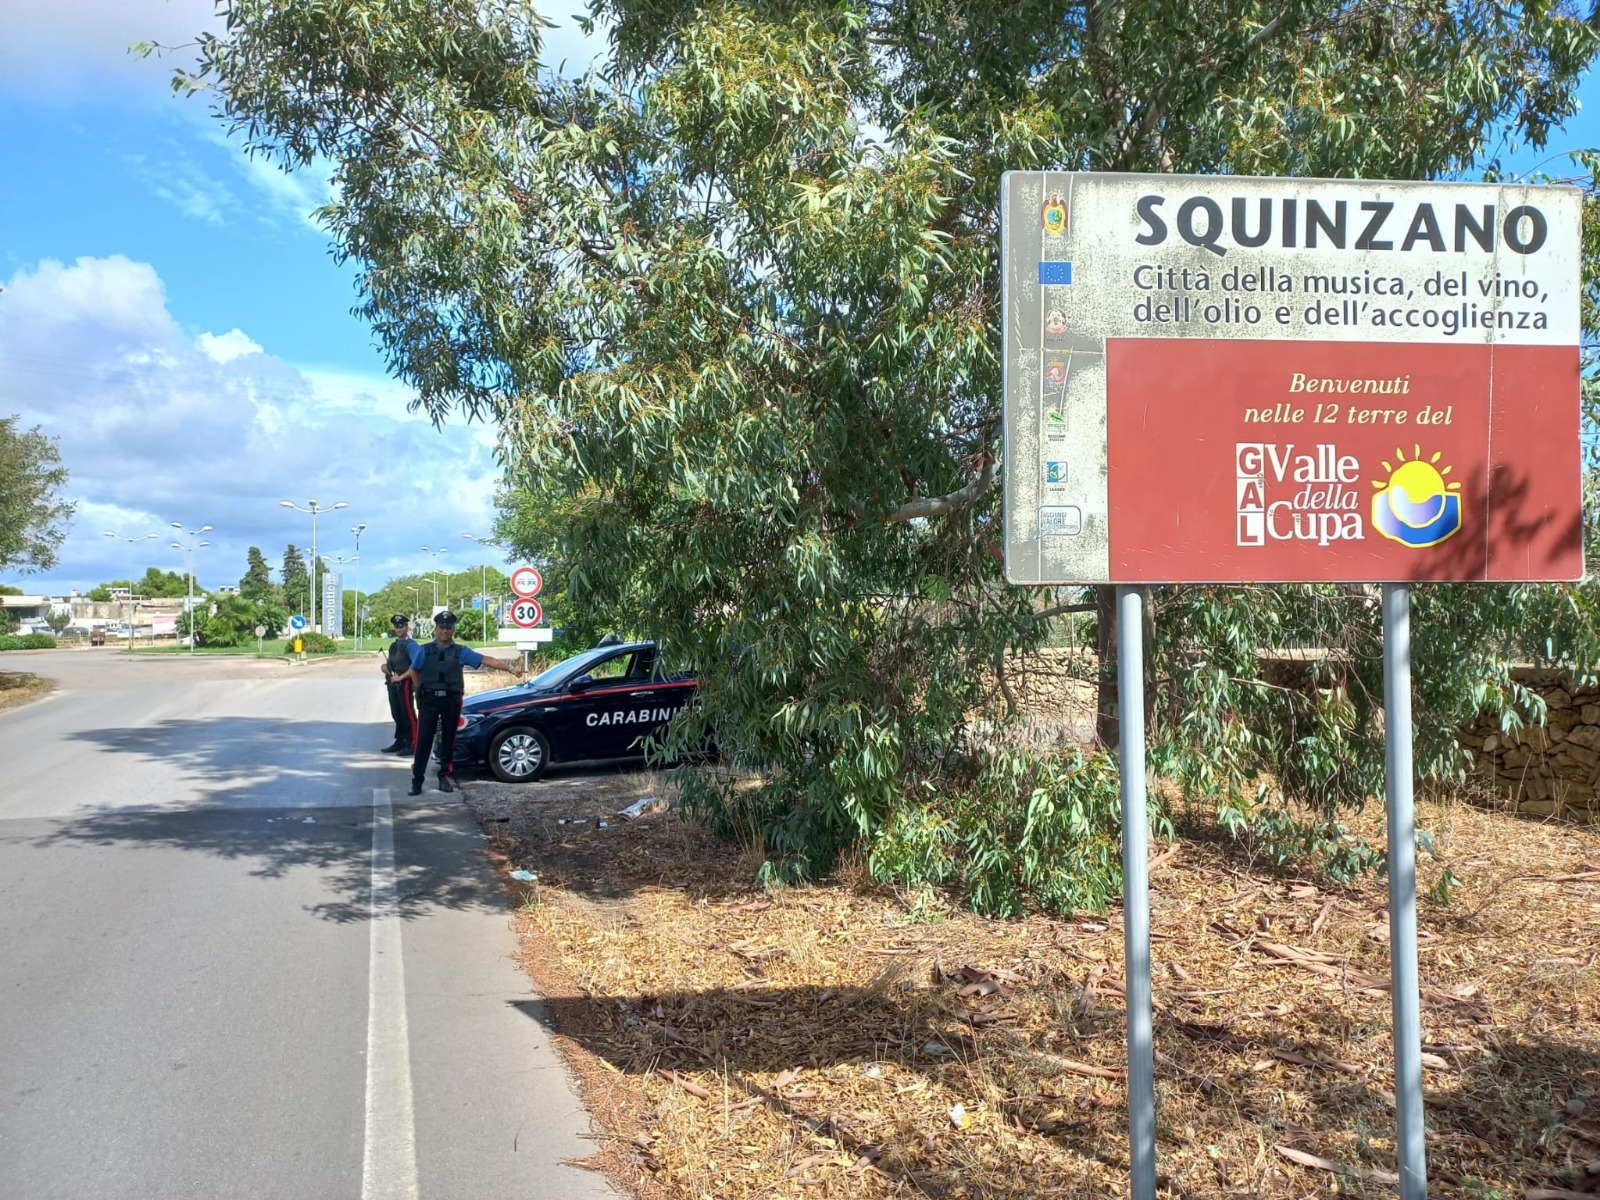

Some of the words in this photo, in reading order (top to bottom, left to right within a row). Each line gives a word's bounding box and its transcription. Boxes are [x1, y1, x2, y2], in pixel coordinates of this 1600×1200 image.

[1135, 195, 1548, 257] SQUINZANO
[1133, 264, 1210, 291] Città
[1221, 265, 1293, 292] della
[1303, 269, 1414, 300] musica,
[1423, 271, 1467, 296] del
[1477, 272, 1548, 304] vino,
[1133, 297, 1262, 324] dell'olio
[1275, 306, 1291, 325] e
[1304, 300, 1548, 336] dell'accoglienza
[1289, 373, 1410, 395] Benvenuti
[1244, 403, 1305, 423] nelle
[1313, 404, 1339, 423] 12
[1348, 406, 1408, 424] terre
[1416, 405, 1453, 425] del
[1265, 443, 1360, 483] Valle
[1238, 445, 1264, 544] GAL
[1293, 483, 1359, 510] della
[1266, 500, 1365, 546] Cupa
[517, 606, 536, 620] 30
